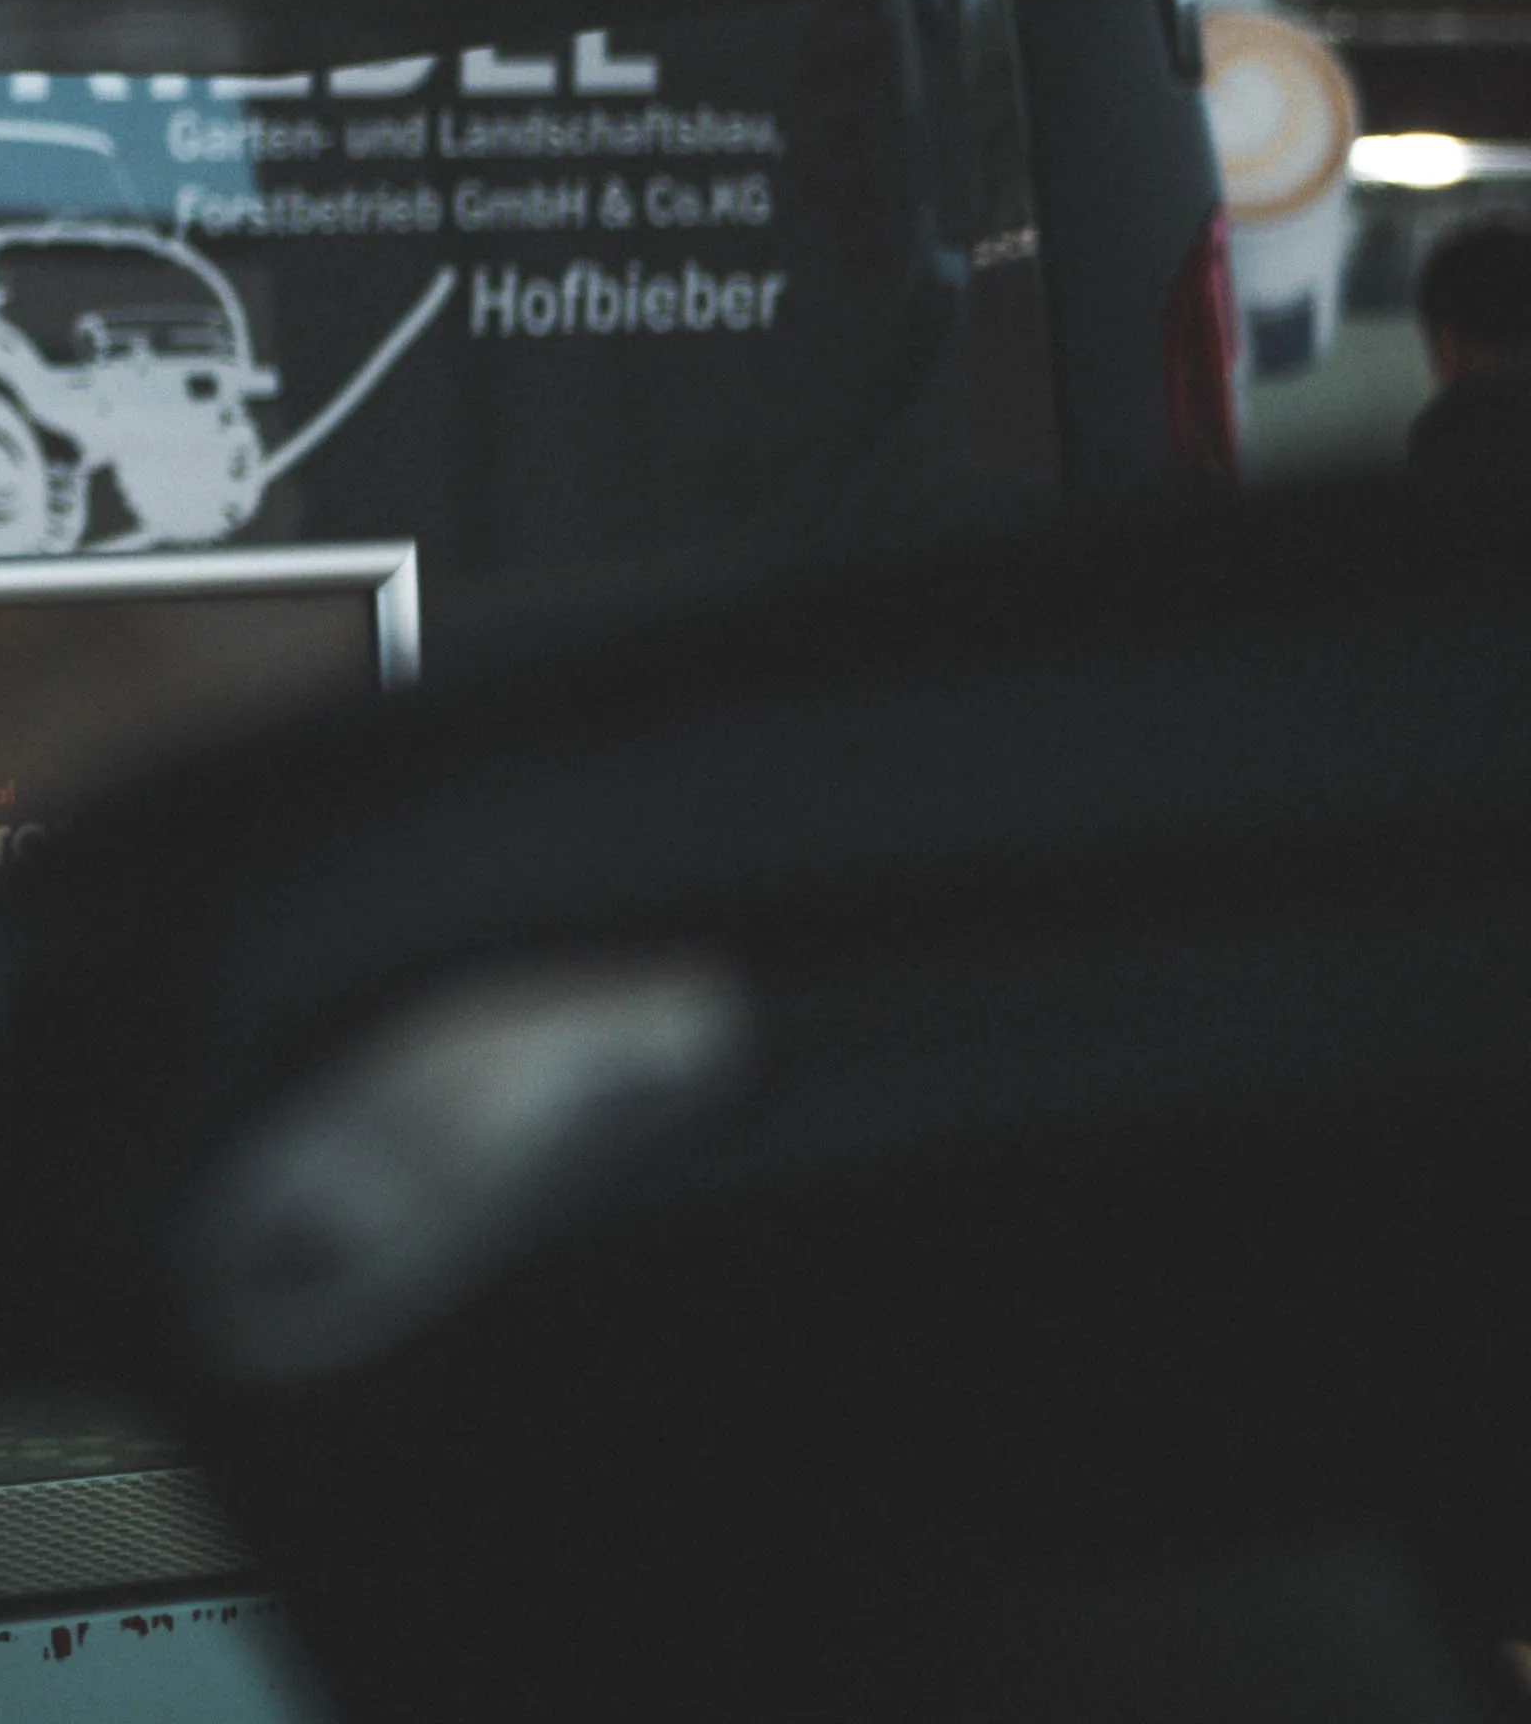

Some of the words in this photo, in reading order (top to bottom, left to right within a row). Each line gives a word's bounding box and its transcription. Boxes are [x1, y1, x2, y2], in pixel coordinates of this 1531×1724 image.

[345, 107, 425, 158] und
[176, 184, 442, 239] Forstbetrieb
[453, 180, 586, 232] GmbH
[601, 178, 633, 230] &
[470, 259, 785, 339] Hofbieber
